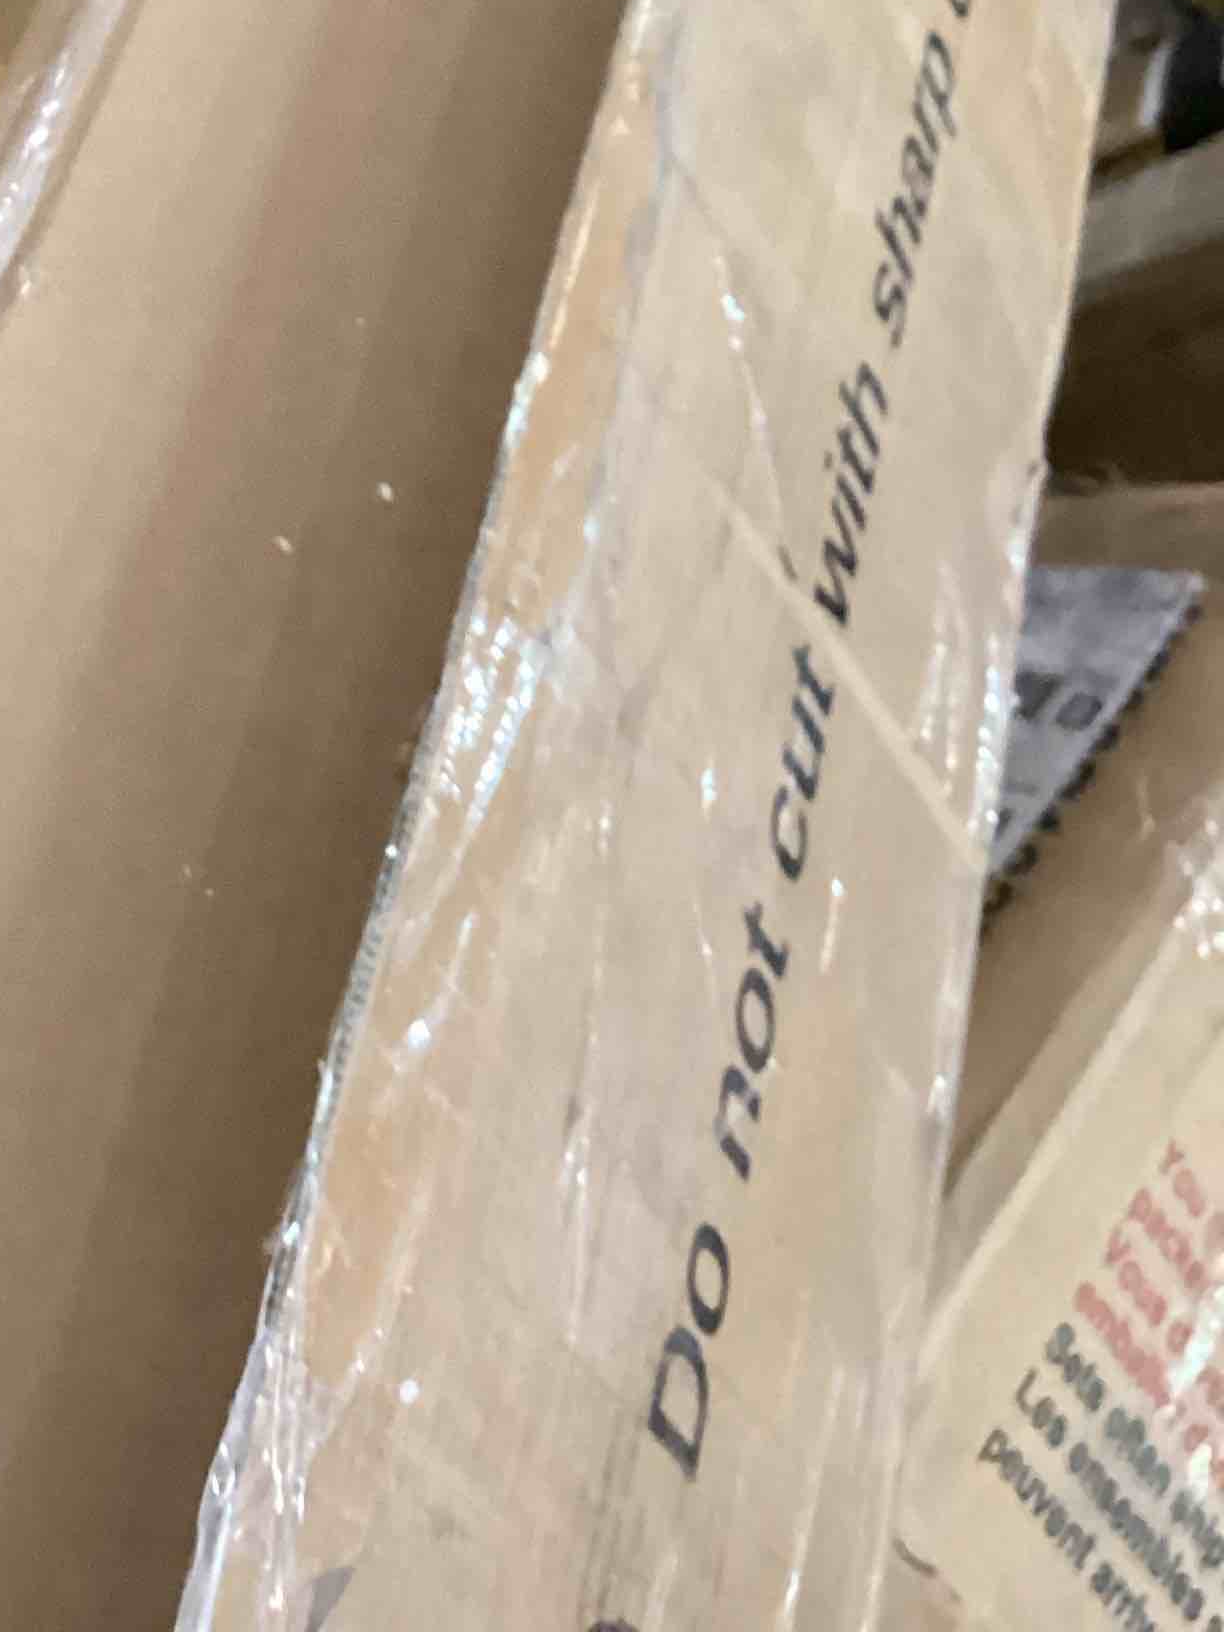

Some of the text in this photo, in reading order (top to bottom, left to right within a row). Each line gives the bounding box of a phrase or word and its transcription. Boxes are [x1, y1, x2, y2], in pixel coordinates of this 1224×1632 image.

[647, 1220, 730, 1483] Do
[713, 899, 790, 1183] not
[770, 642, 834, 884] cut
[811, 360, 890, 626] with
[873, 30, 957, 350] sharp
